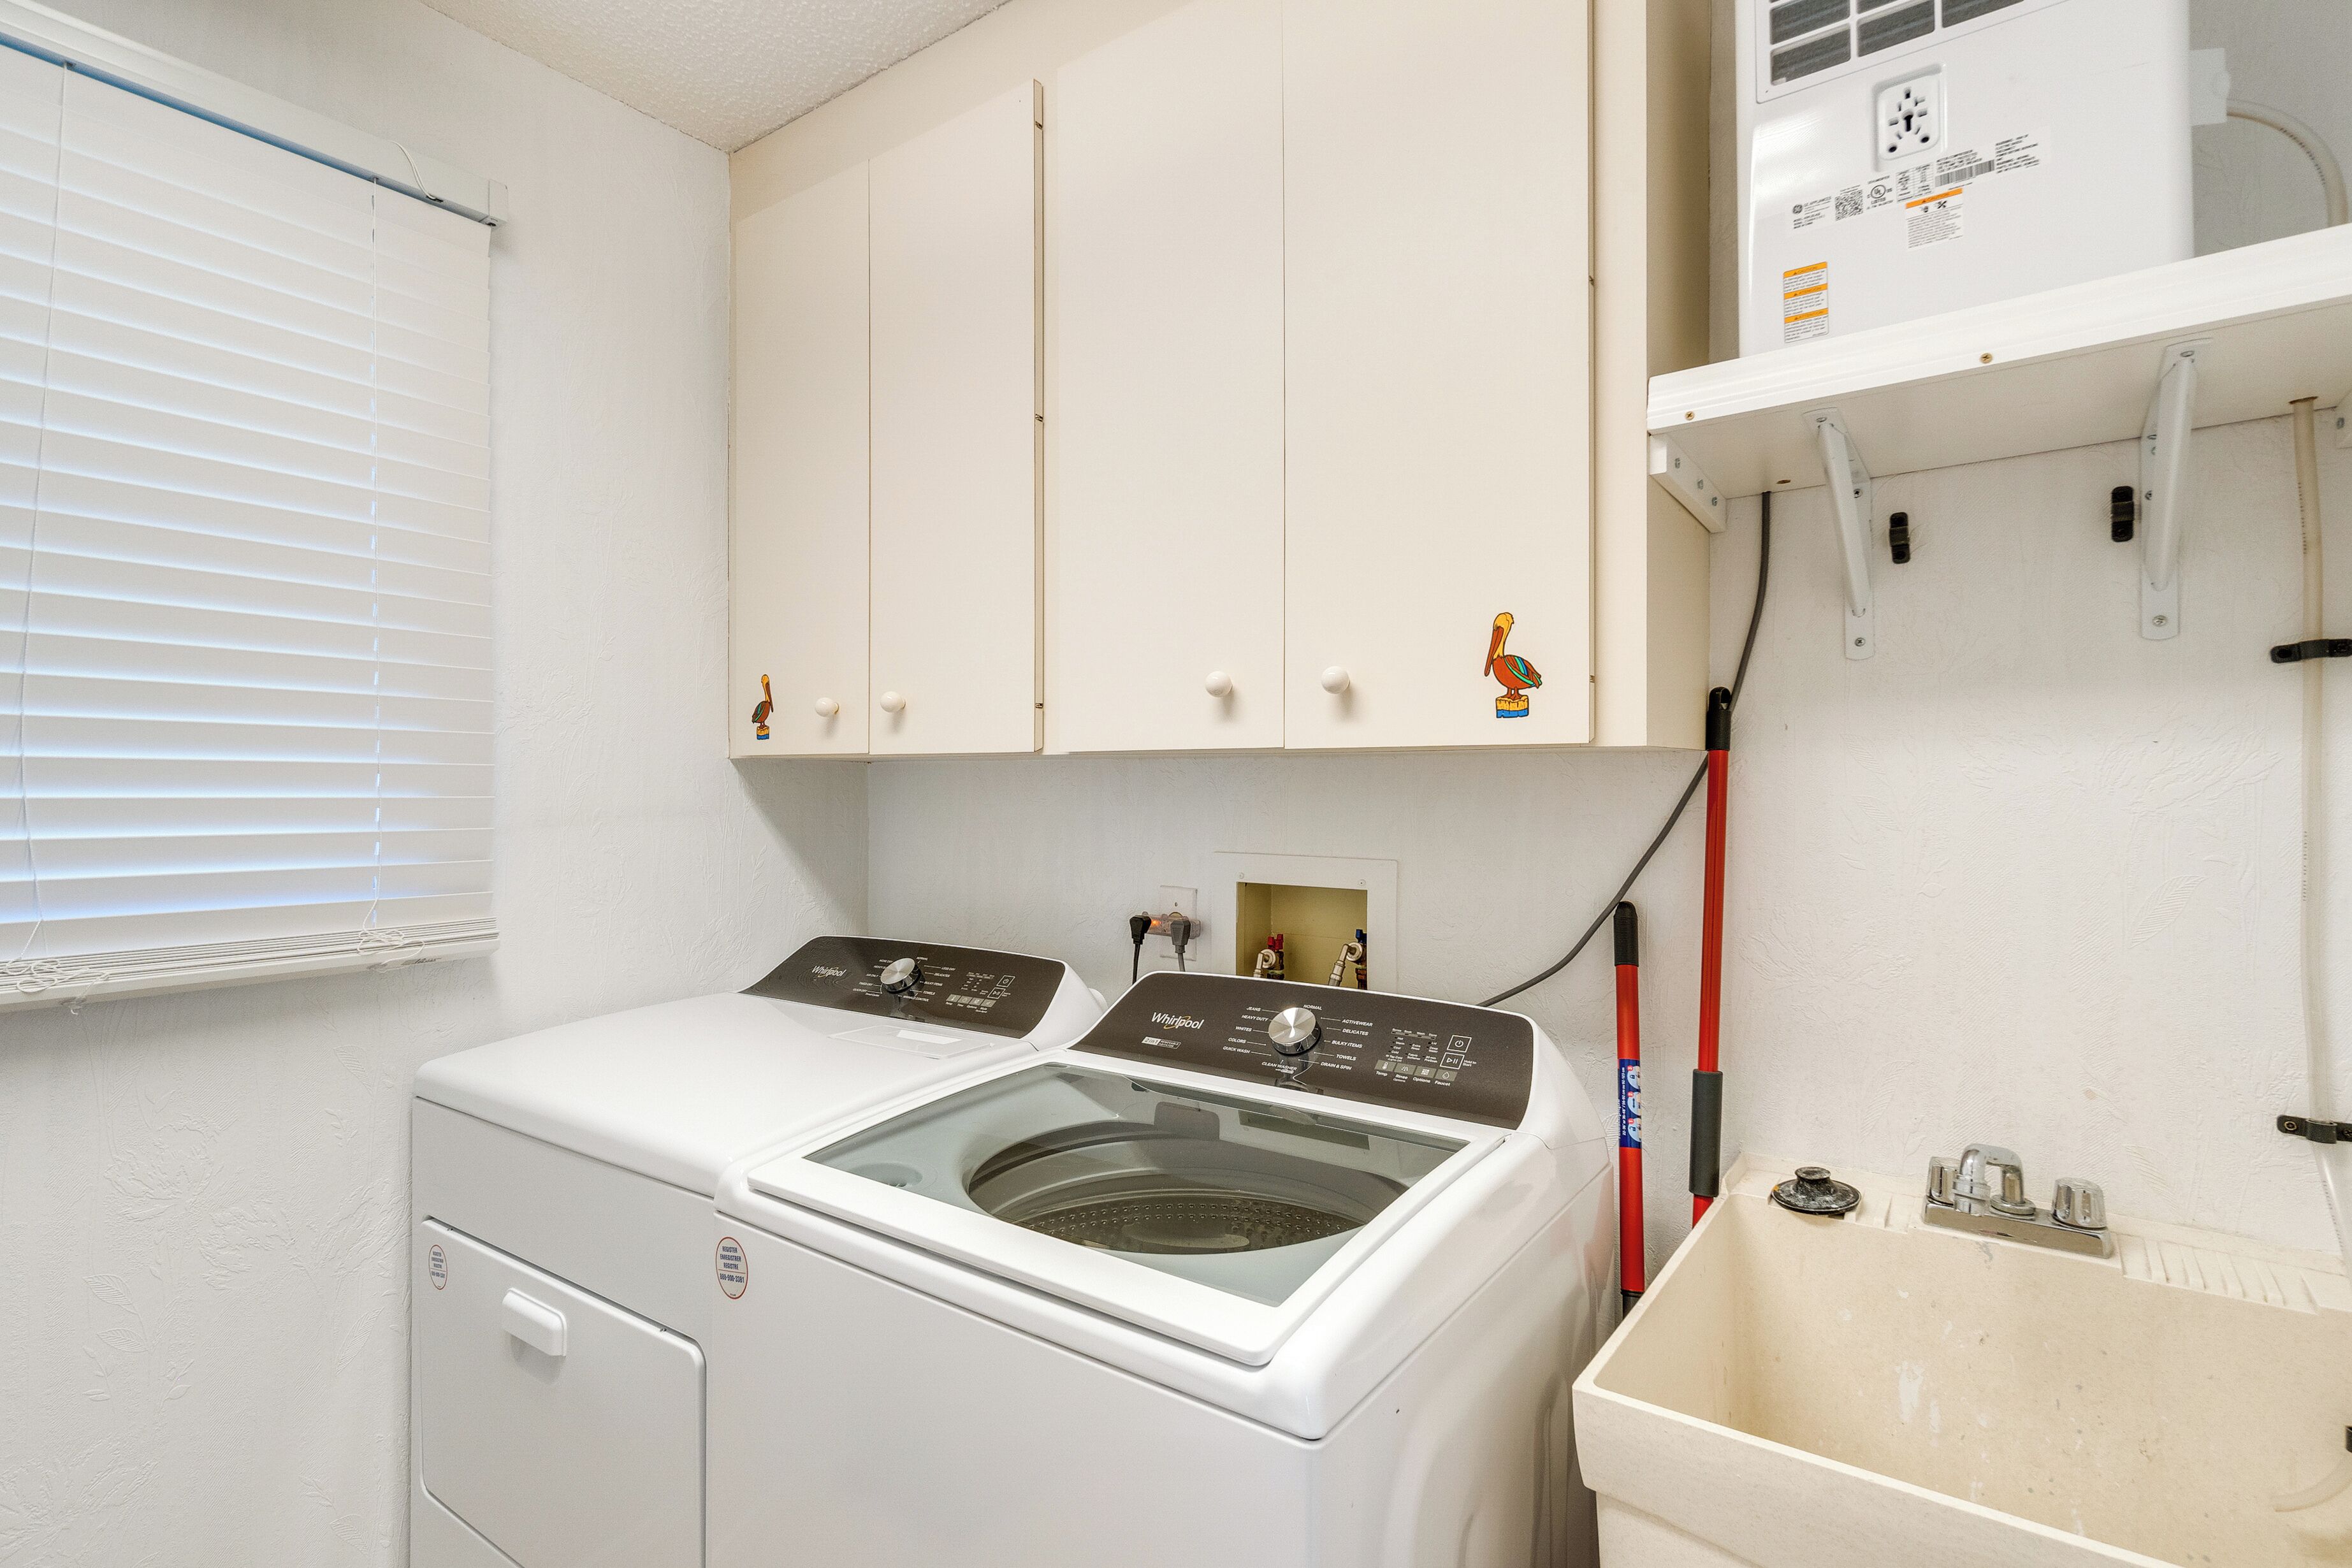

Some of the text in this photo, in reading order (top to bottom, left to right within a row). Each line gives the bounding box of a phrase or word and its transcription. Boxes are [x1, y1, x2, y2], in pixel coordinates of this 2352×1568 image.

[811, 965, 846, 978] Whirlpool
[1151, 1012, 1205, 1029] Whirlpool
[722, 1245, 737, 1254] REGISTER
[720, 1254, 741, 1262] ENREGISTRER
[723, 1262, 739, 1270] REGISTRE
